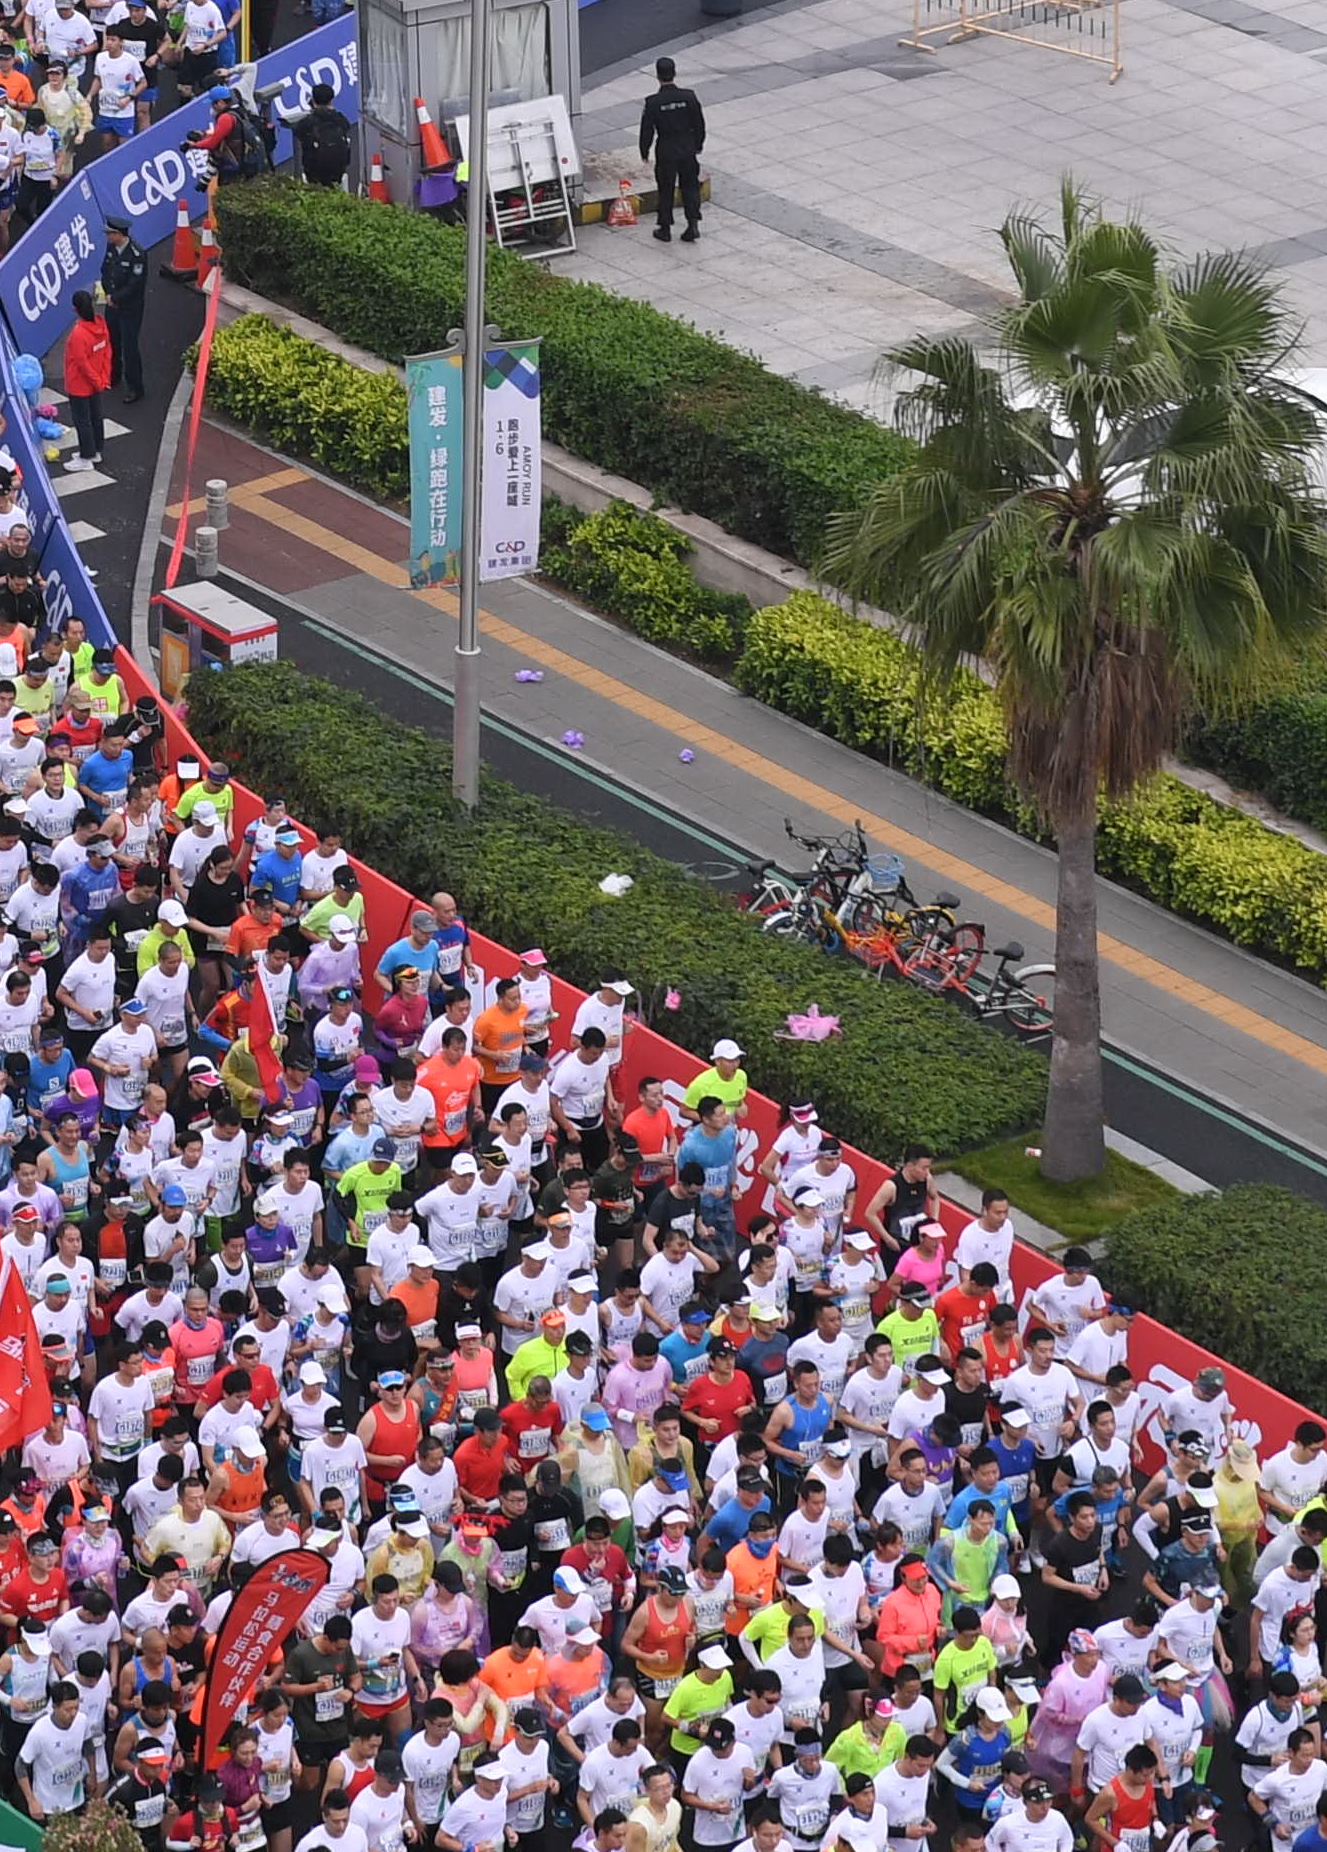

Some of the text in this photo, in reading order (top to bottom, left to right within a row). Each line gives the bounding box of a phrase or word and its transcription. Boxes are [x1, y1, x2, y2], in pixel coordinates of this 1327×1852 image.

[120, 149, 186, 216] C&D
[18, 213, 95, 322] C&D 建发
[522, 446, 532, 505] AMOY RUN
[488, 555, 532, 569] 建发集团
[495, 541, 525, 554] C&D
[223, 1591, 280, 1668] 马拉松运动
